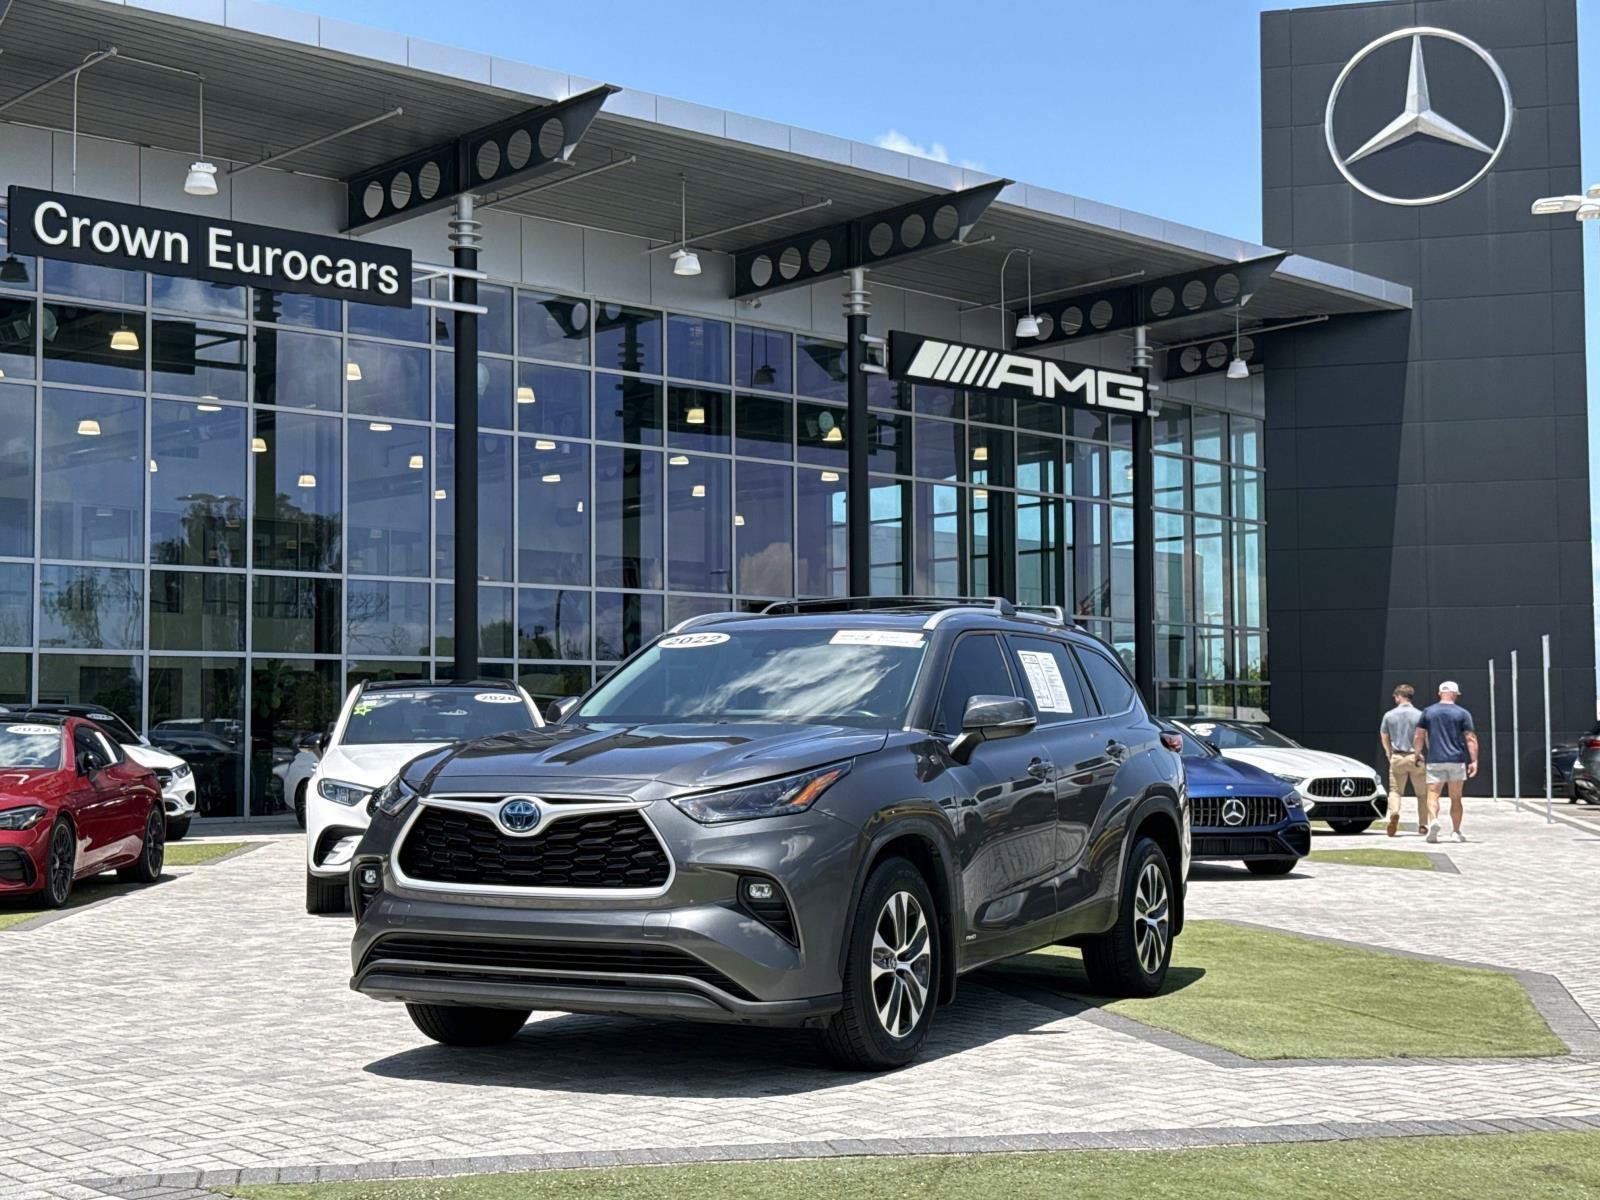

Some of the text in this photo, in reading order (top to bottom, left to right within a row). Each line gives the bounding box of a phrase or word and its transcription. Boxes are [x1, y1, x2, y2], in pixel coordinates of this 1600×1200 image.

[33, 200, 400, 295] Crown Eurocars
[987, 353, 1144, 413] AMG
[664, 635, 723, 646] 2022
